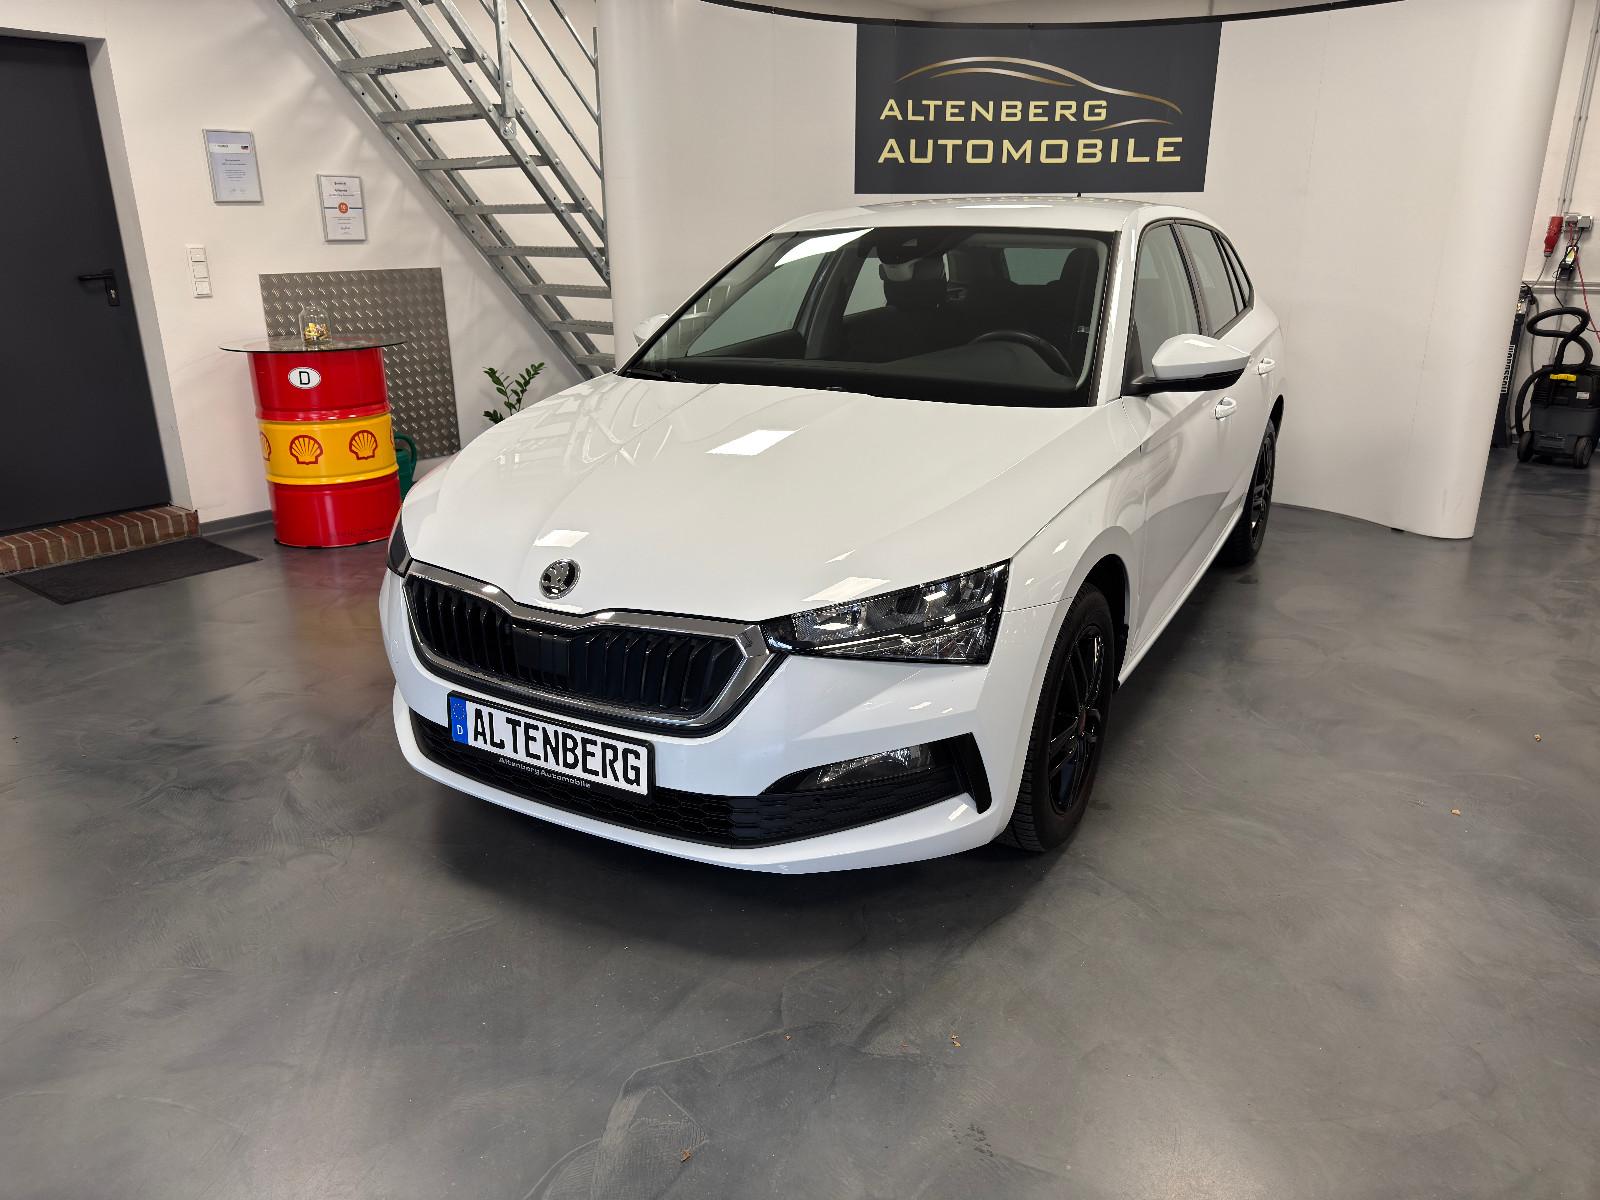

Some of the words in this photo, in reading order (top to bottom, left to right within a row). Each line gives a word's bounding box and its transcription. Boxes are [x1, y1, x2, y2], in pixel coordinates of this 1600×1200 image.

[880, 98, 1108, 122] ALTENBERG
[877, 136, 1183, 164] AUTOMOBILE
[298, 370, 311, 386] D
[457, 724, 464, 735] D
[473, 707, 641, 787] ALTENBERG
[498, 757, 540, 776] Altenberg
[540, 769, 592, 789] Automobile
